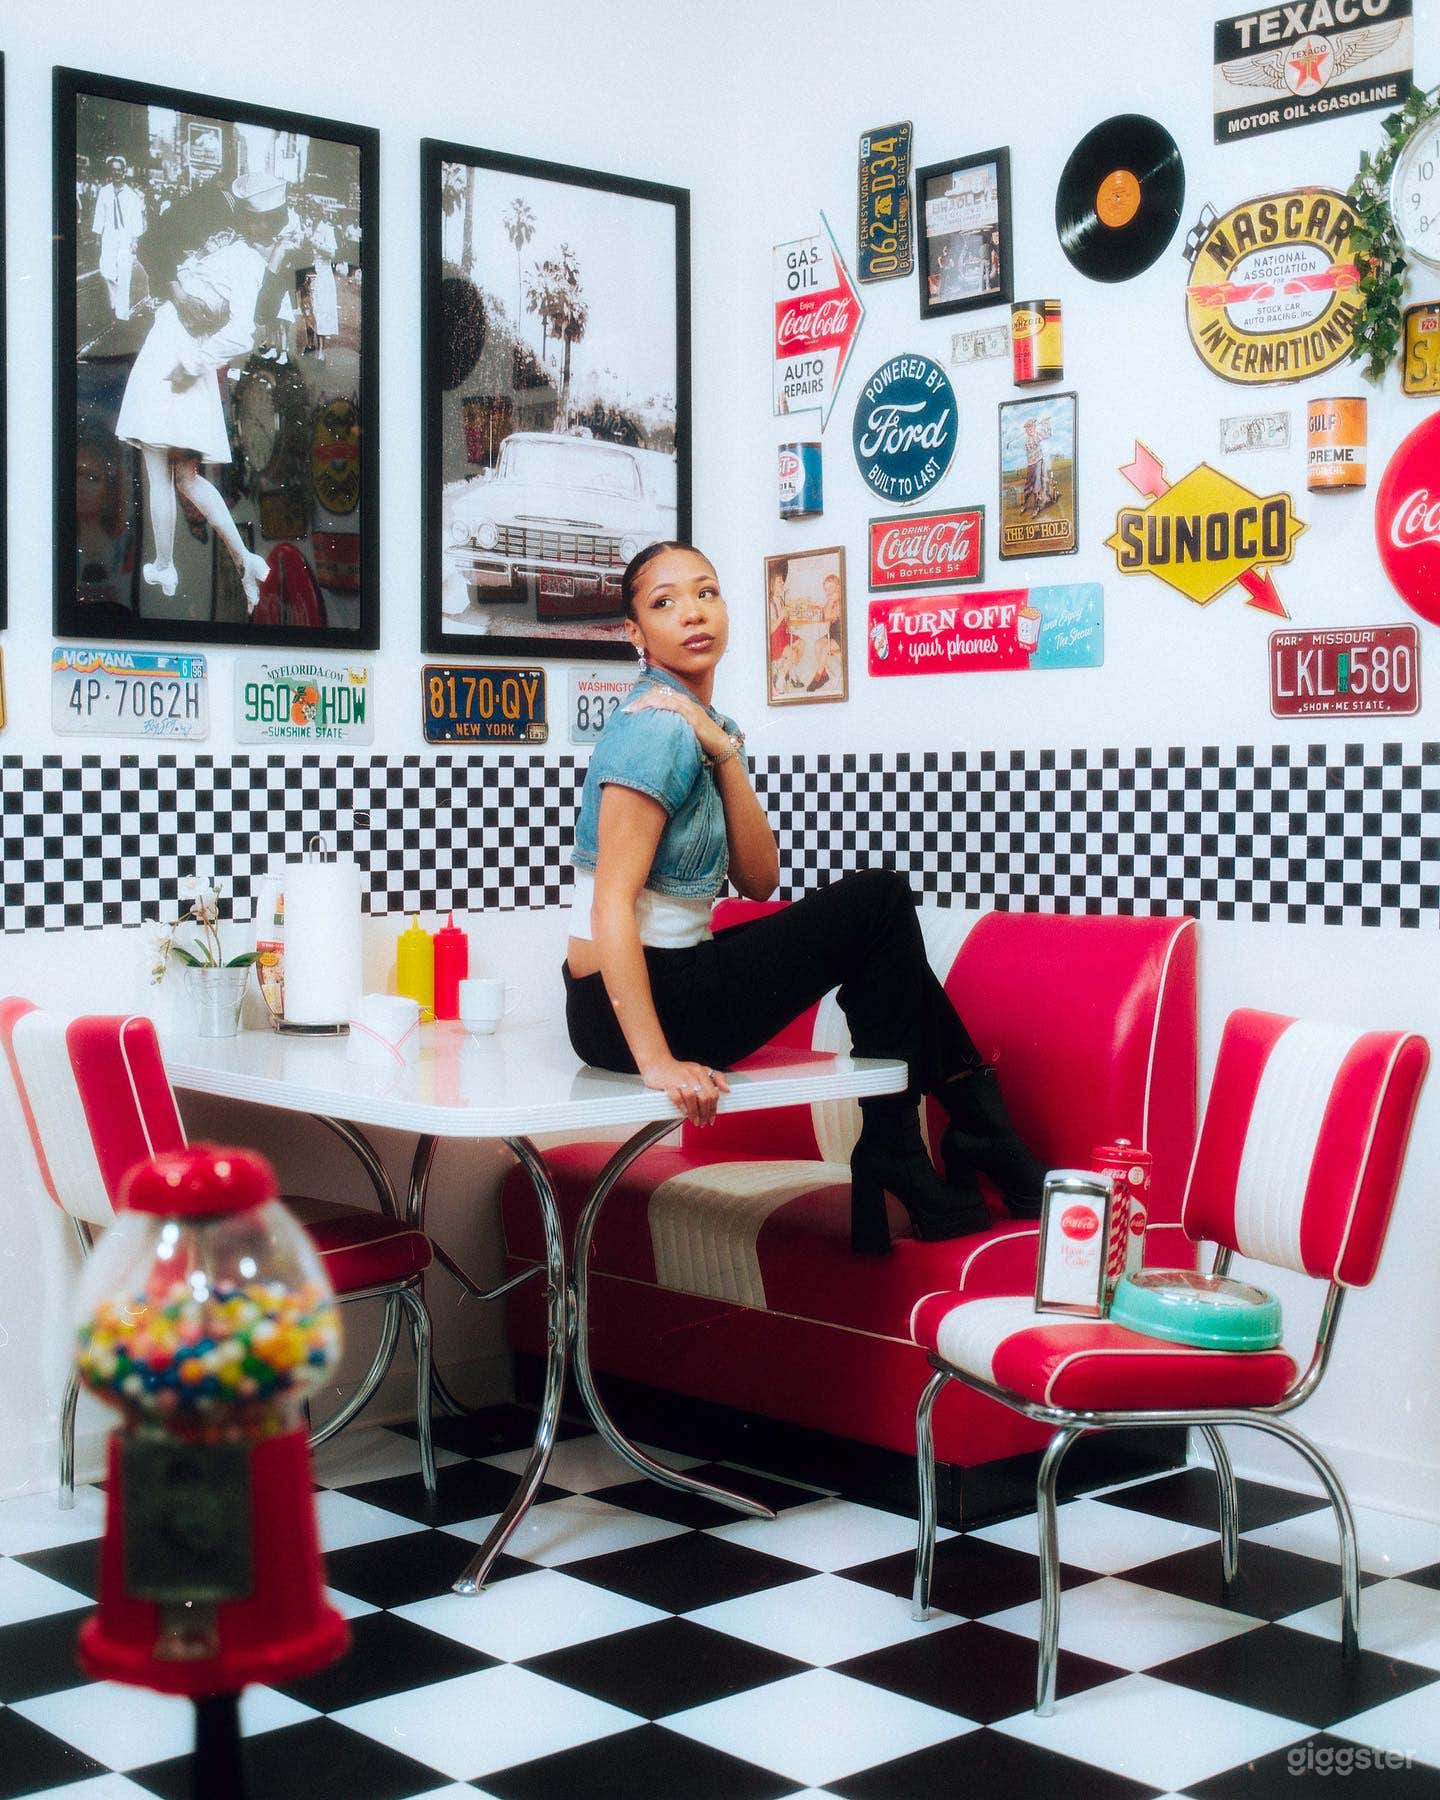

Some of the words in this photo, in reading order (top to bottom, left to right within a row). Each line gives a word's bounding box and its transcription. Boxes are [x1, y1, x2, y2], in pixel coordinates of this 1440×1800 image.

[1234, 0, 1390, 49] TEXACO
[1290, 44, 1327, 59] TEXACO
[1228, 111, 1280, 134] MOTOR
[1283, 104, 1310, 121] OIL
[1318, 84, 1398, 113] GASOLINE
[871, 136, 898, 193] D34
[898, 156, 907, 186] STATE
[1418, 161, 1434, 182] 10
[860, 165, 869, 249] PENNSYLVANIA
[1411, 193, 1421, 211] 9
[1205, 198, 1356, 272] NASCAR
[1419, 215, 1430, 233] 8
[786, 246, 819, 270] GAS
[869, 219, 899, 274] 062
[1253, 250, 1307, 268] NATIONAL
[787, 267, 819, 291] OIL
[1244, 261, 1316, 281] ASSOCIATION
[1256, 304, 1282, 315] STOCK
[1285, 302, 1301, 312] CAR
[777, 297, 852, 346] Coca-Cola
[1243, 316, 1265, 326] AUTO
[784, 359, 824, 382] AUTO
[865, 359, 926, 403] POWERED
[925, 369, 946, 394] BY
[784, 378, 824, 399] REPAIRS
[859, 400, 950, 458] Ford
[1308, 414, 1336, 433] GULF
[1308, 448, 1354, 464] PREME
[867, 463, 897, 494] BUILT
[898, 478, 912, 496] TO
[913, 456, 941, 490] LAST
[901, 525, 931, 536] DRINK
[1005, 527, 1024, 541] THE
[1041, 521, 1068, 538] HOLE
[1120, 499, 1287, 567] SUNOCO
[876, 519, 976, 570] Coca-Cola
[886, 571, 896, 580] IN
[900, 567, 942, 578] BOTTLES
[888, 607, 960, 637] TURN
[963, 604, 1018, 631] OFF
[908, 636, 945, 665] your
[947, 633, 999, 662] phones
[1276, 636, 1297, 646] MAR
[1312, 632, 1376, 645] MISSOURI
[62, 650, 136, 669] MONTANA
[1276, 649, 1335, 697] LKL
[1350, 645, 1412, 695] 580
[244, 683, 291, 722] 960
[322, 686, 366, 724] HDW
[1352, 700, 1385, 710] STATE
[268, 726, 312, 738] SUNSHINE
[315, 727, 343, 739] STATE
[455, 723, 481, 736] NEW
[486, 723, 515, 737] YORK
